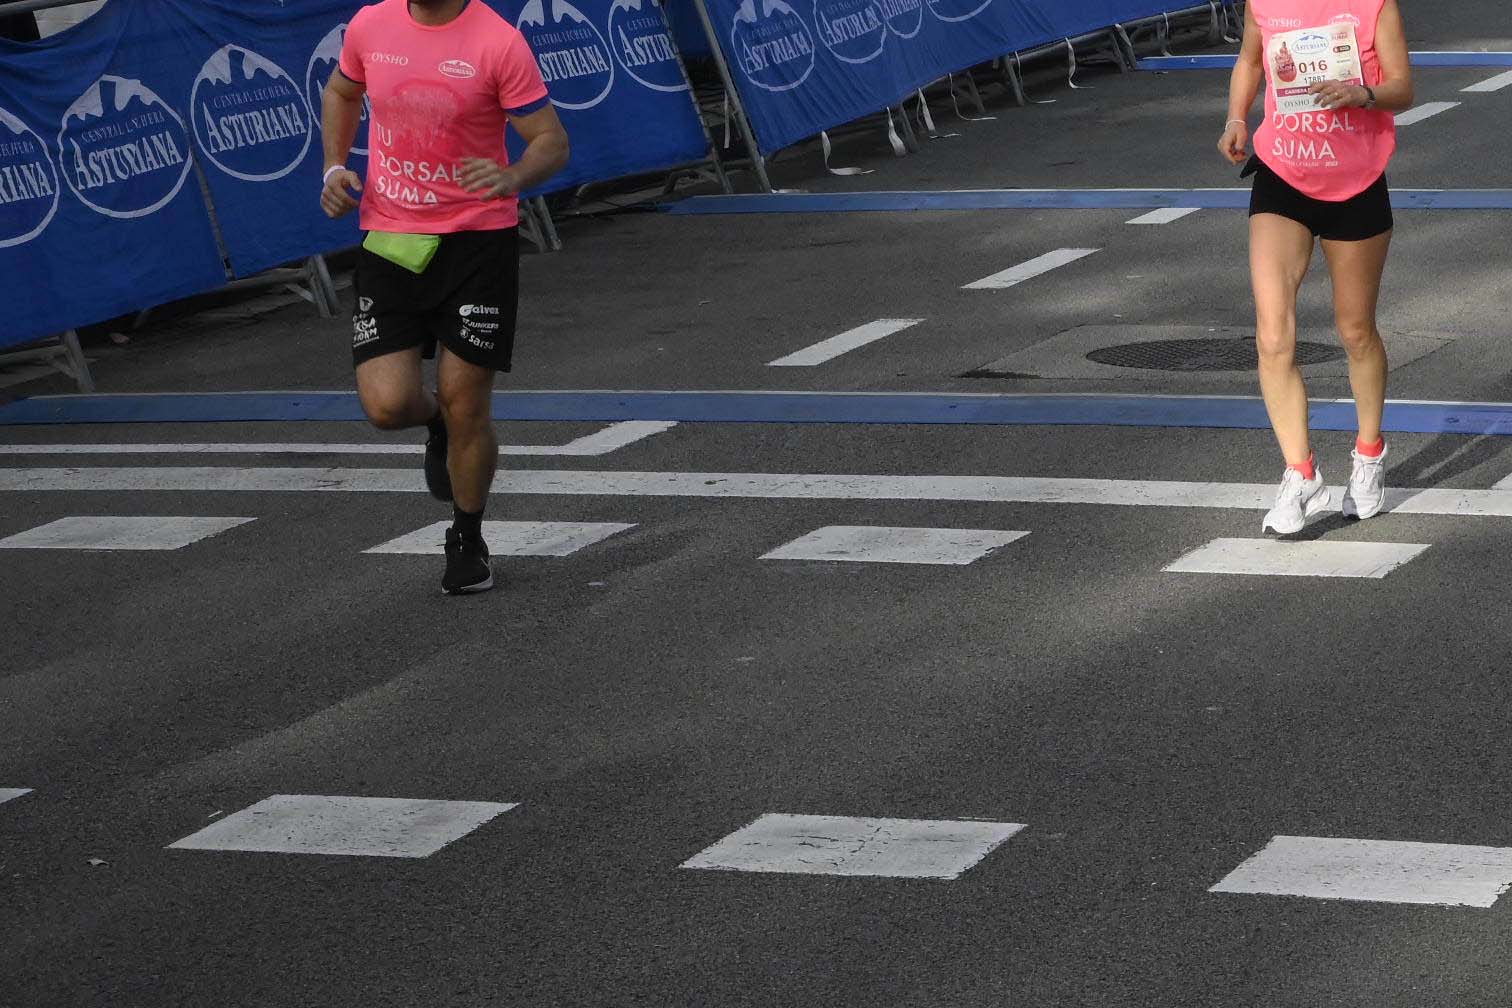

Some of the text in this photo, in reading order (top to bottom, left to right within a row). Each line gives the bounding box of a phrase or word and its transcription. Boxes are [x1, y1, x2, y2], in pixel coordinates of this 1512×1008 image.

[618, 25, 678, 67] ASTUR
[371, 52, 409, 66] OYSHO
[539, 44, 609, 83] STURIANA
[1298, 60, 1328, 73] 016
[202, 101, 307, 154] ASTURIANA
[1272, 112, 1354, 133] DORSAL
[376, 123, 392, 146] TU
[1272, 137, 1335, 160] SUMA
[375, 176, 438, 204] SUMA
